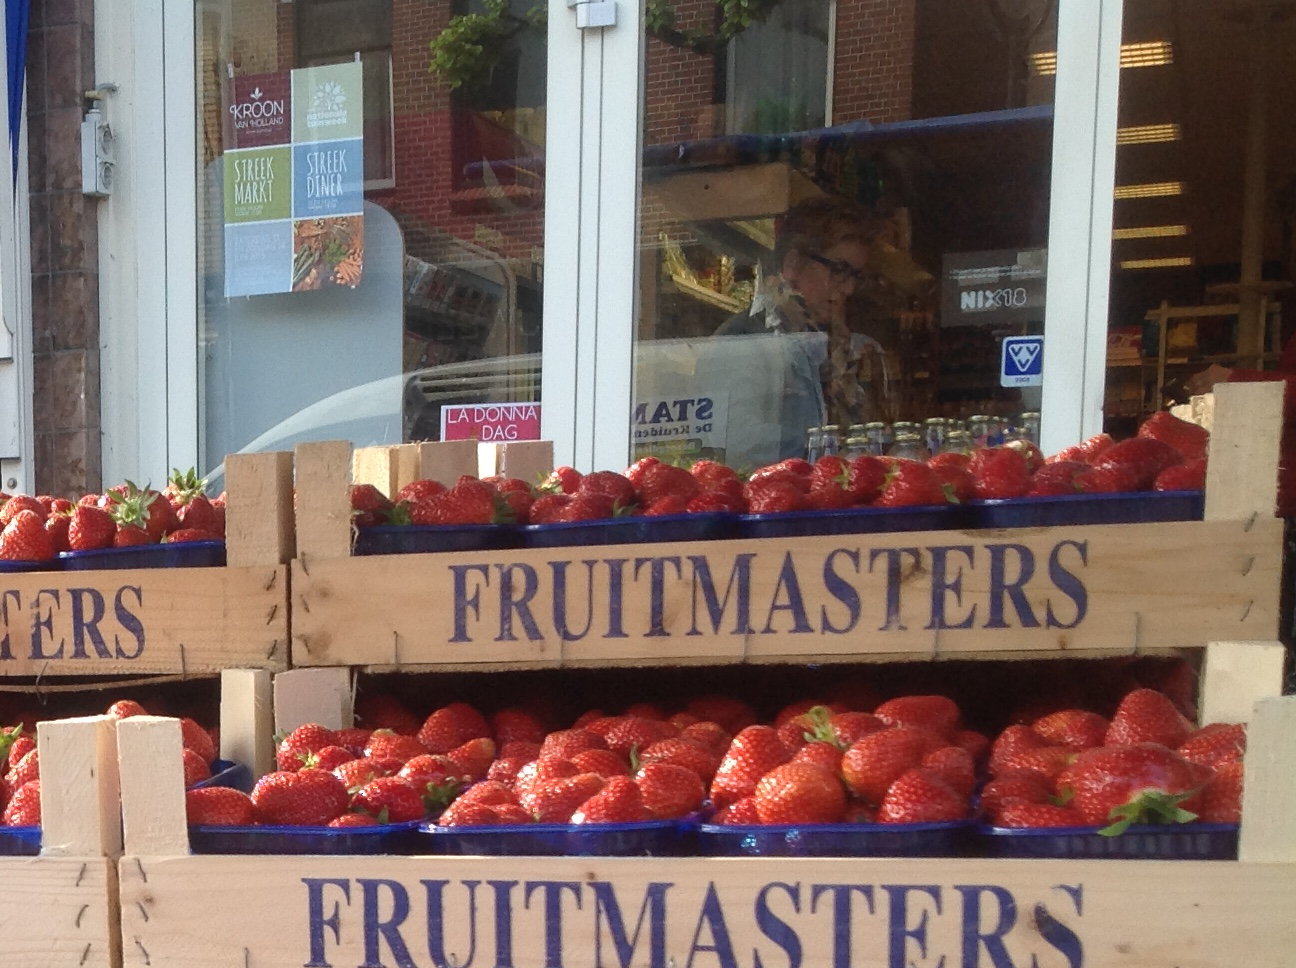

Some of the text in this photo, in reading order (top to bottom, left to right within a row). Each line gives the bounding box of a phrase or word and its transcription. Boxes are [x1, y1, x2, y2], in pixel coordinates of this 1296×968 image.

[229, 100, 284, 120] KROON
[250, 117, 284, 128] HOLLAND
[234, 157, 274, 182] STREEK
[306, 149, 348, 176] STREEK
[234, 180, 273, 205] MARKT
[306, 173, 343, 198] DINER
[960, 288, 1027, 311] NIX18
[447, 406, 538, 424] LA DONNA
[482, 424, 518, 440] DAG
[447, 538, 1090, 644] FRUITMASTERS
